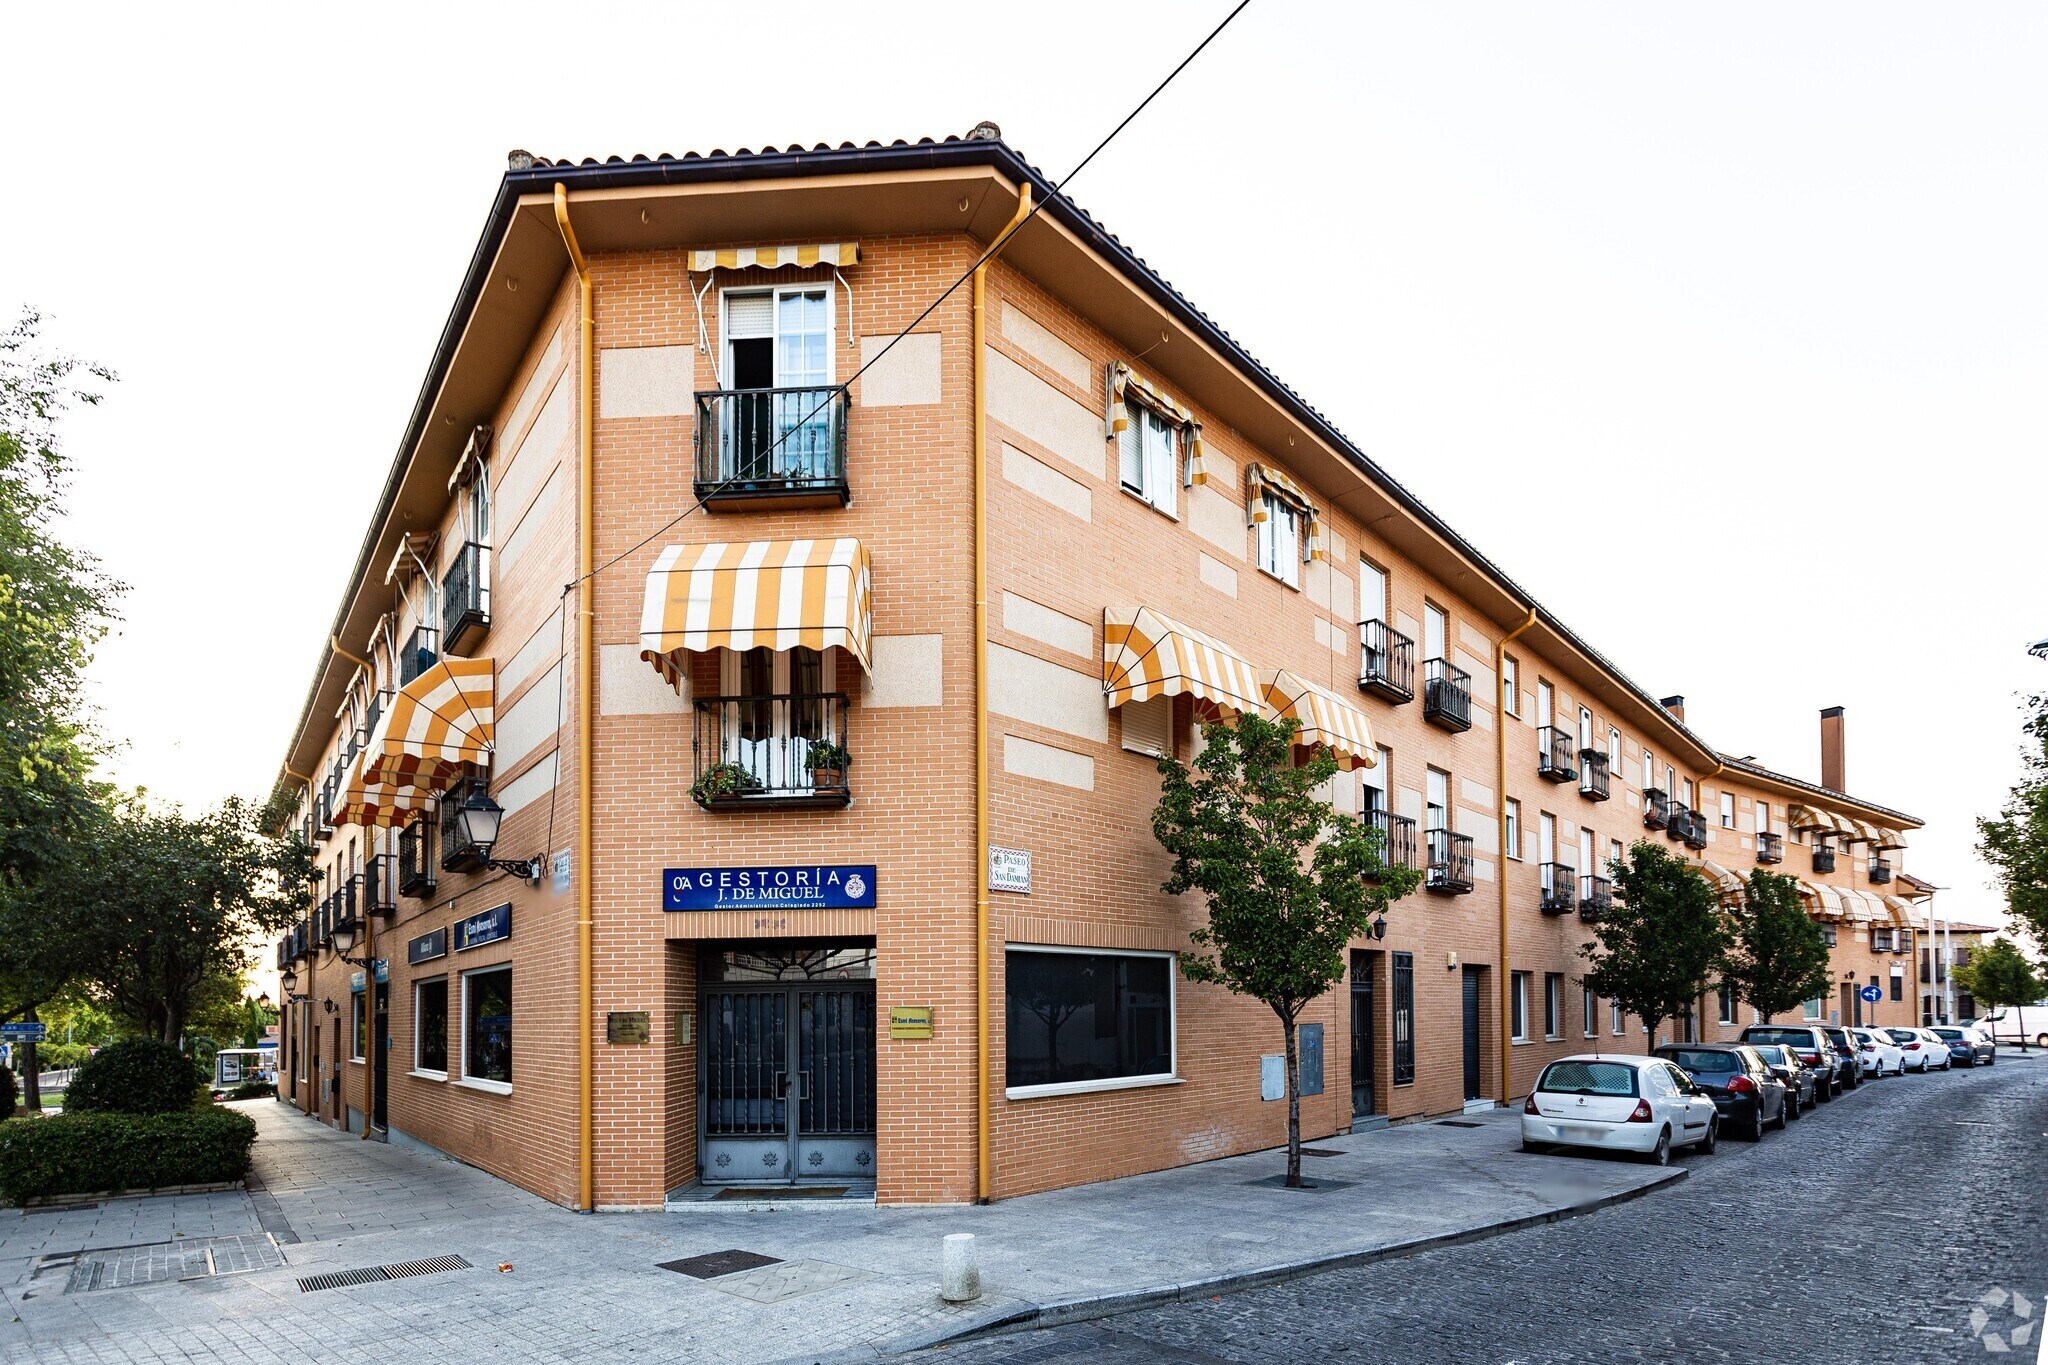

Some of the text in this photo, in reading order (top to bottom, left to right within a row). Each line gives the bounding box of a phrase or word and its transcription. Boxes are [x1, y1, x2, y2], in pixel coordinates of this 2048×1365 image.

[1003, 854, 1026, 866] PASEO
[699, 868, 841, 887] GESTORÍA
[994, 870, 1006, 881] SAN
[717, 885, 824, 903] J. DE MIGUEL
